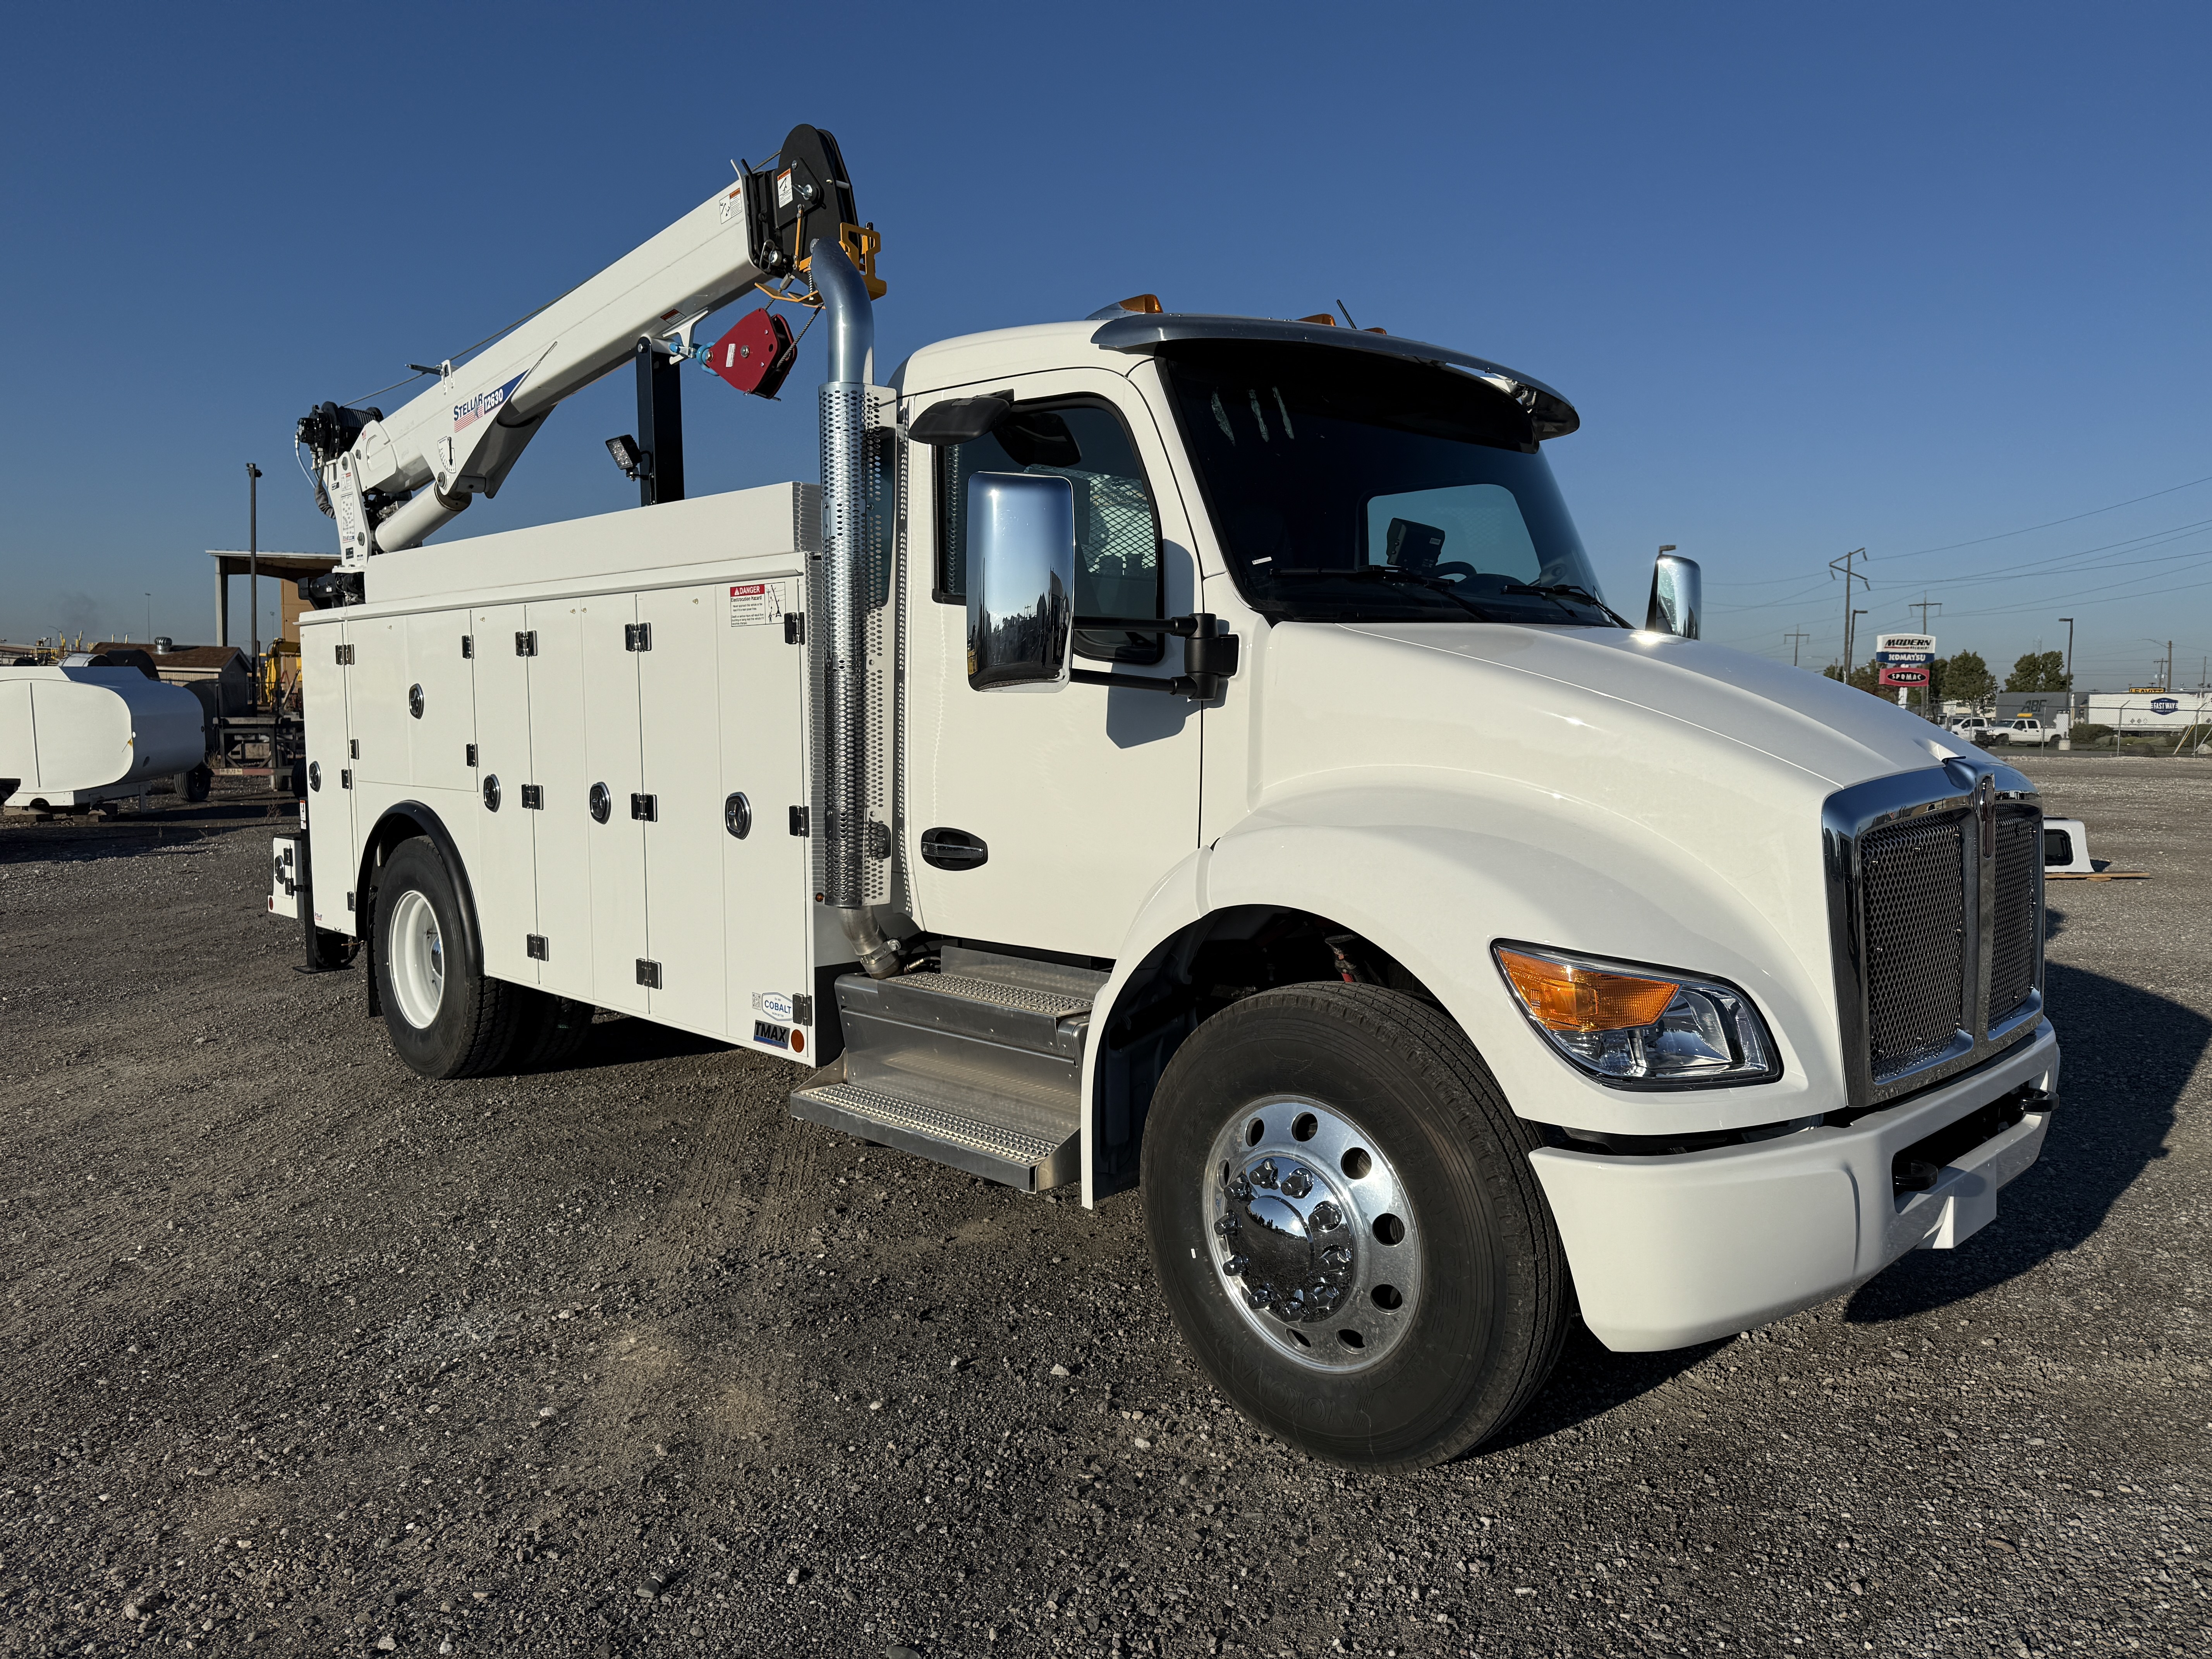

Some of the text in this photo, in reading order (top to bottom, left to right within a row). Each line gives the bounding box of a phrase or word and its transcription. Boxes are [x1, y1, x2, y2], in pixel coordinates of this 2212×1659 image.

[454, 388, 503, 421] STELLAR 12630
[739, 586, 760, 595] DANGER
[1888, 653, 1926, 661] KOMATSU
[2021, 699, 2047, 712] ABF
[764, 1000, 792, 1014] COBALT
[756, 1022, 787, 1043] TMAX
[1199, 1310, 1340, 1428] YOKOHAMA
